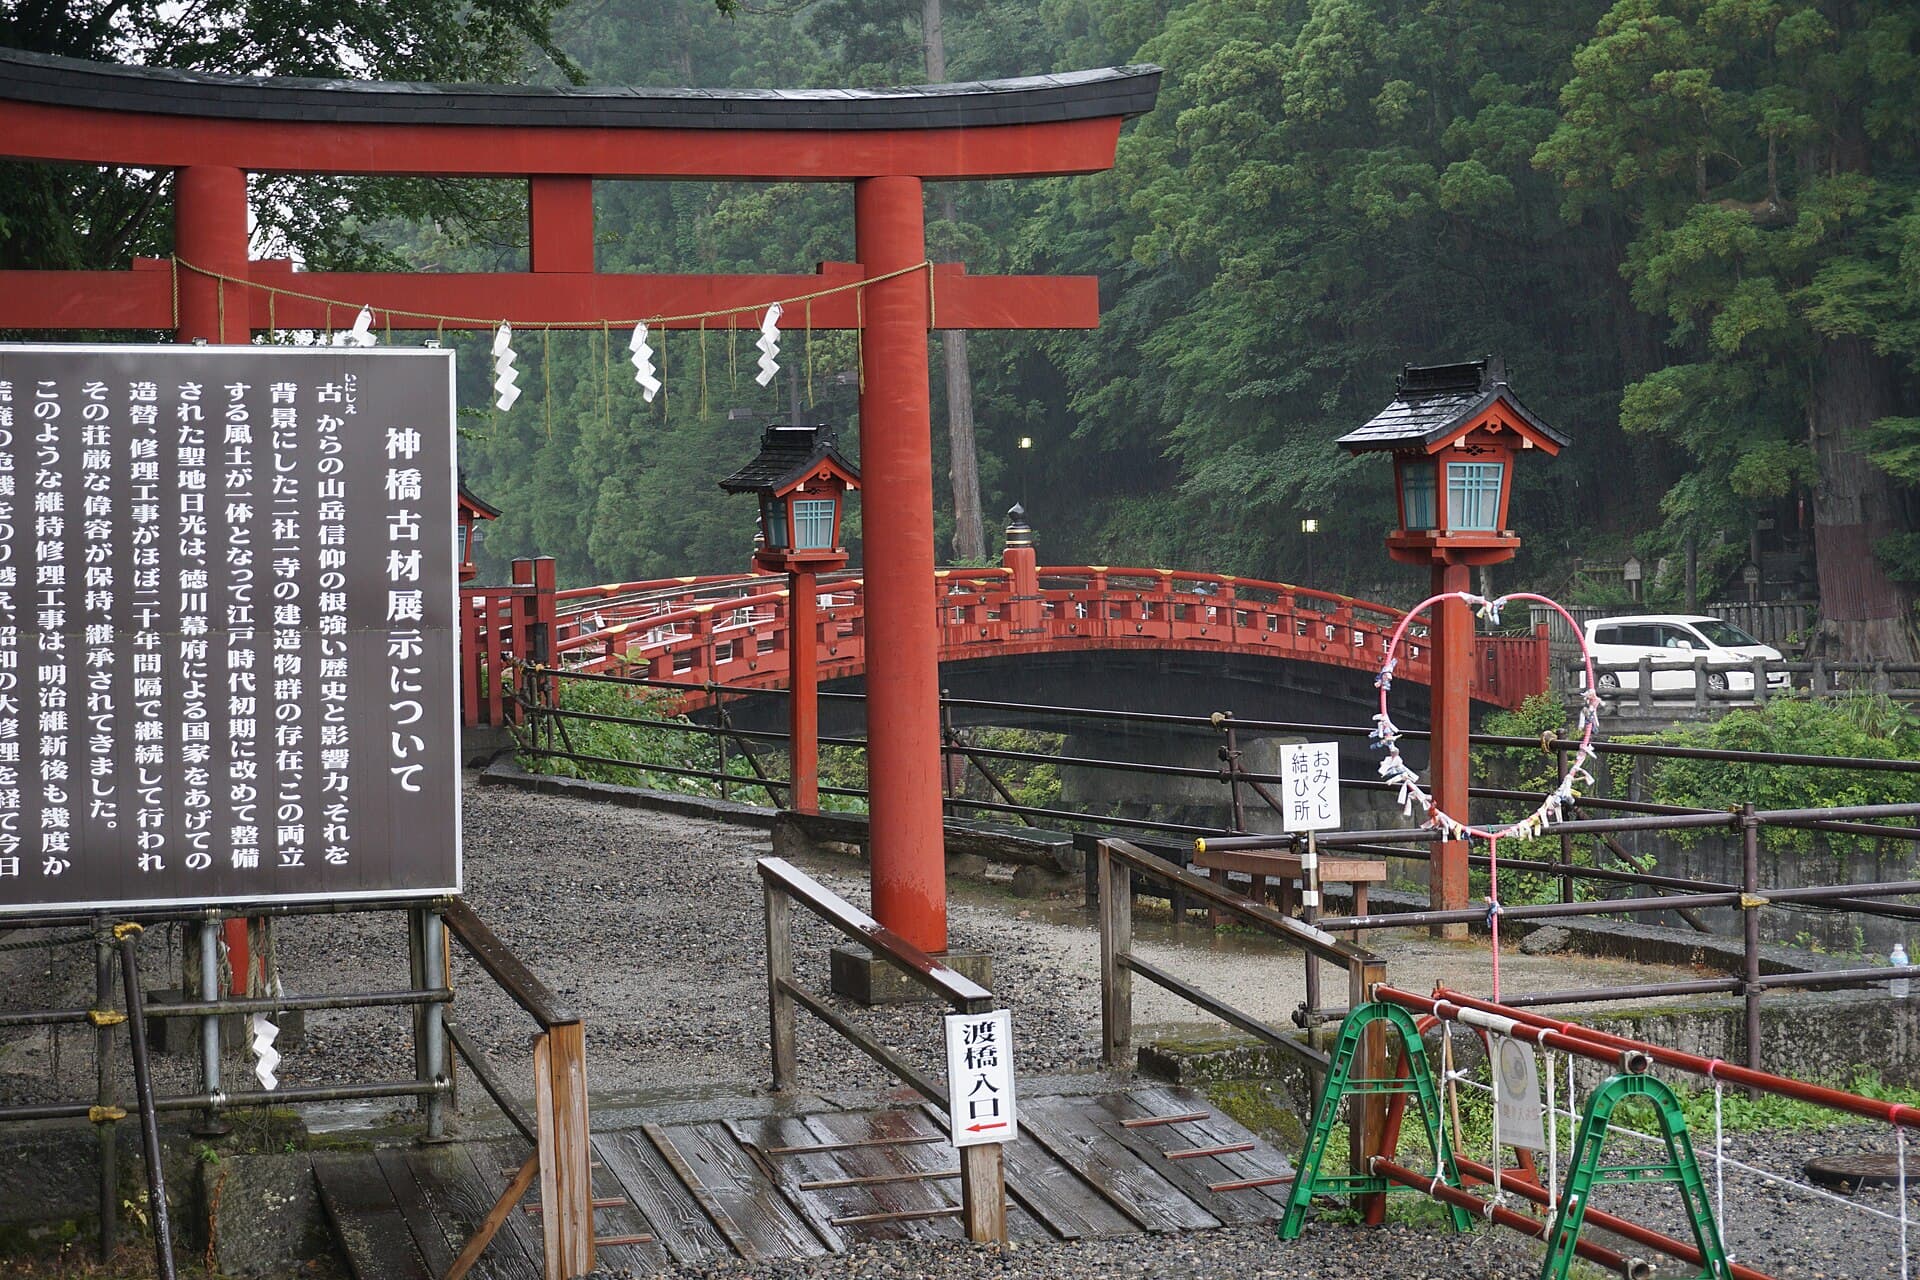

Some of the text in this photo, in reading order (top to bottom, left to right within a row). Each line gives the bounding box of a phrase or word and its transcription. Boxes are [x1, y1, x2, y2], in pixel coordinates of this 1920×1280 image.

[81, 381, 117, 829] その荘厳な偉容が保持、継承されてきました。
[129, 381, 166, 872] 造替、修理工事がほぼ二十年間隔で継続して行われ
[176, 381, 213, 870] された聖地日光は、徳川幕府による国家をあげての
[223, 381, 260, 869] する風土が一体となって江戸時代初期に改めて整備
[269, 382, 306, 867] 背景にした二社一寺の建造物群の存在、この両立
[315, 382, 351, 865] 古からの山岳信仰の根強い歴史と影響力、それを
[344, 373, 357, 415] いにしえ
[385, 427, 425, 793] 神橋古材展示について
[34, 380, 71, 875] このような維持修理工事は、明治維新後も幾度か
[1291, 752, 1310, 821] 結び所
[1312, 750, 1331, 820] おみくじ
[962, 1020, 1000, 1120] 渡橋入口
